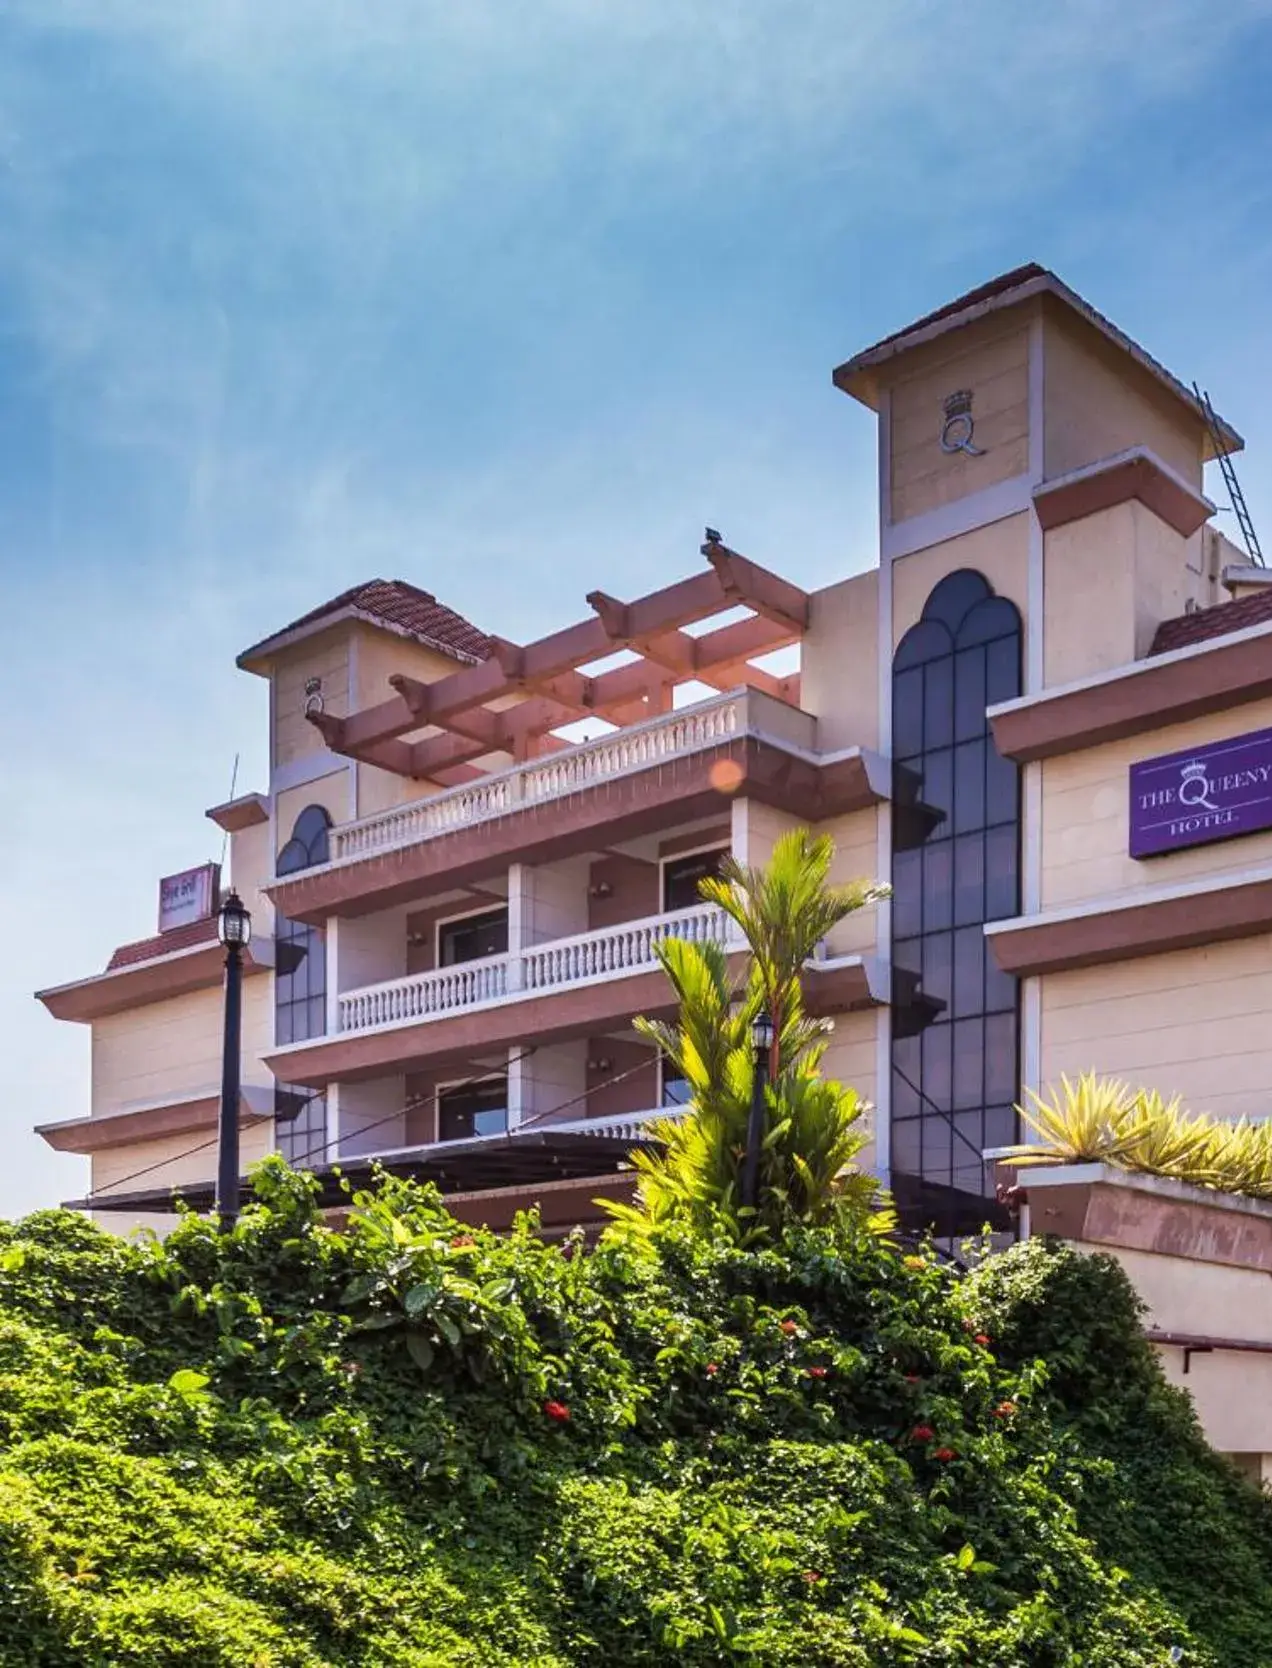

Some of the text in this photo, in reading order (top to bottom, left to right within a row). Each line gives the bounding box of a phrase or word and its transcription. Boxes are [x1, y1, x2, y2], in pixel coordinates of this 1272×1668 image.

[1138, 764, 1272, 810] THE QUEENY
[1170, 810, 1239, 836] HOTEL
